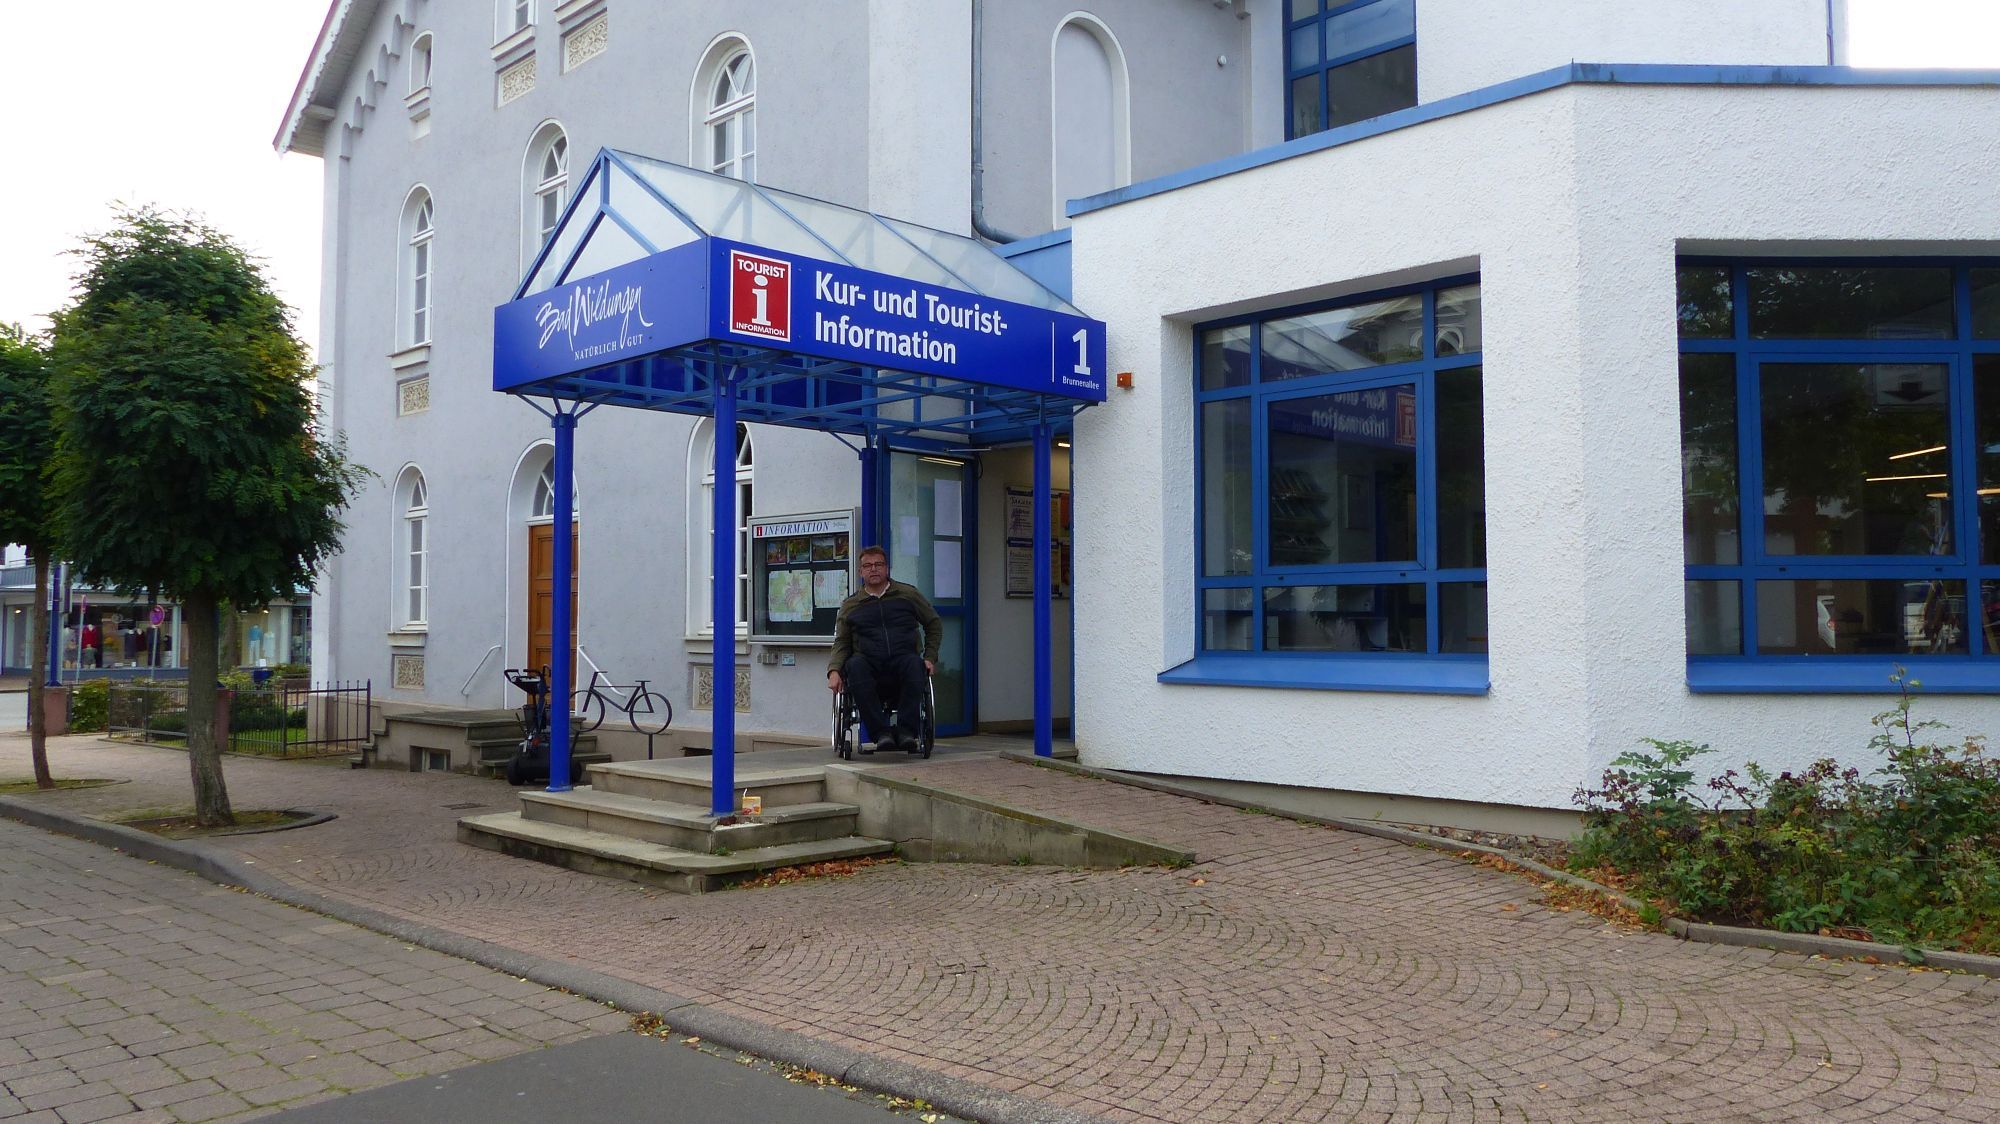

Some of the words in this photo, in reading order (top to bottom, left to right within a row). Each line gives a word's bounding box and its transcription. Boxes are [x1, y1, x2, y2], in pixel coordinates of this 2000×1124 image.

[737, 259, 785, 278] TOURIST
[536, 295, 574, 352] Bad
[573, 279, 653, 349] Wildungen
[751, 275, 771, 326] i
[816, 271, 866, 306] Kur-
[873, 290, 917, 318] und
[924, 294, 1008, 336] Tourist-
[574, 340, 617, 361] NATÜRLICH
[627, 334, 643, 347] GUT
[736, 321, 785, 337] INFORMATION
[815, 312, 956, 364] Information
[1072, 328, 1091, 376] 1
[1062, 375, 1100, 390] Brunnenallee
[764, 521, 829, 536] INFORMATION
